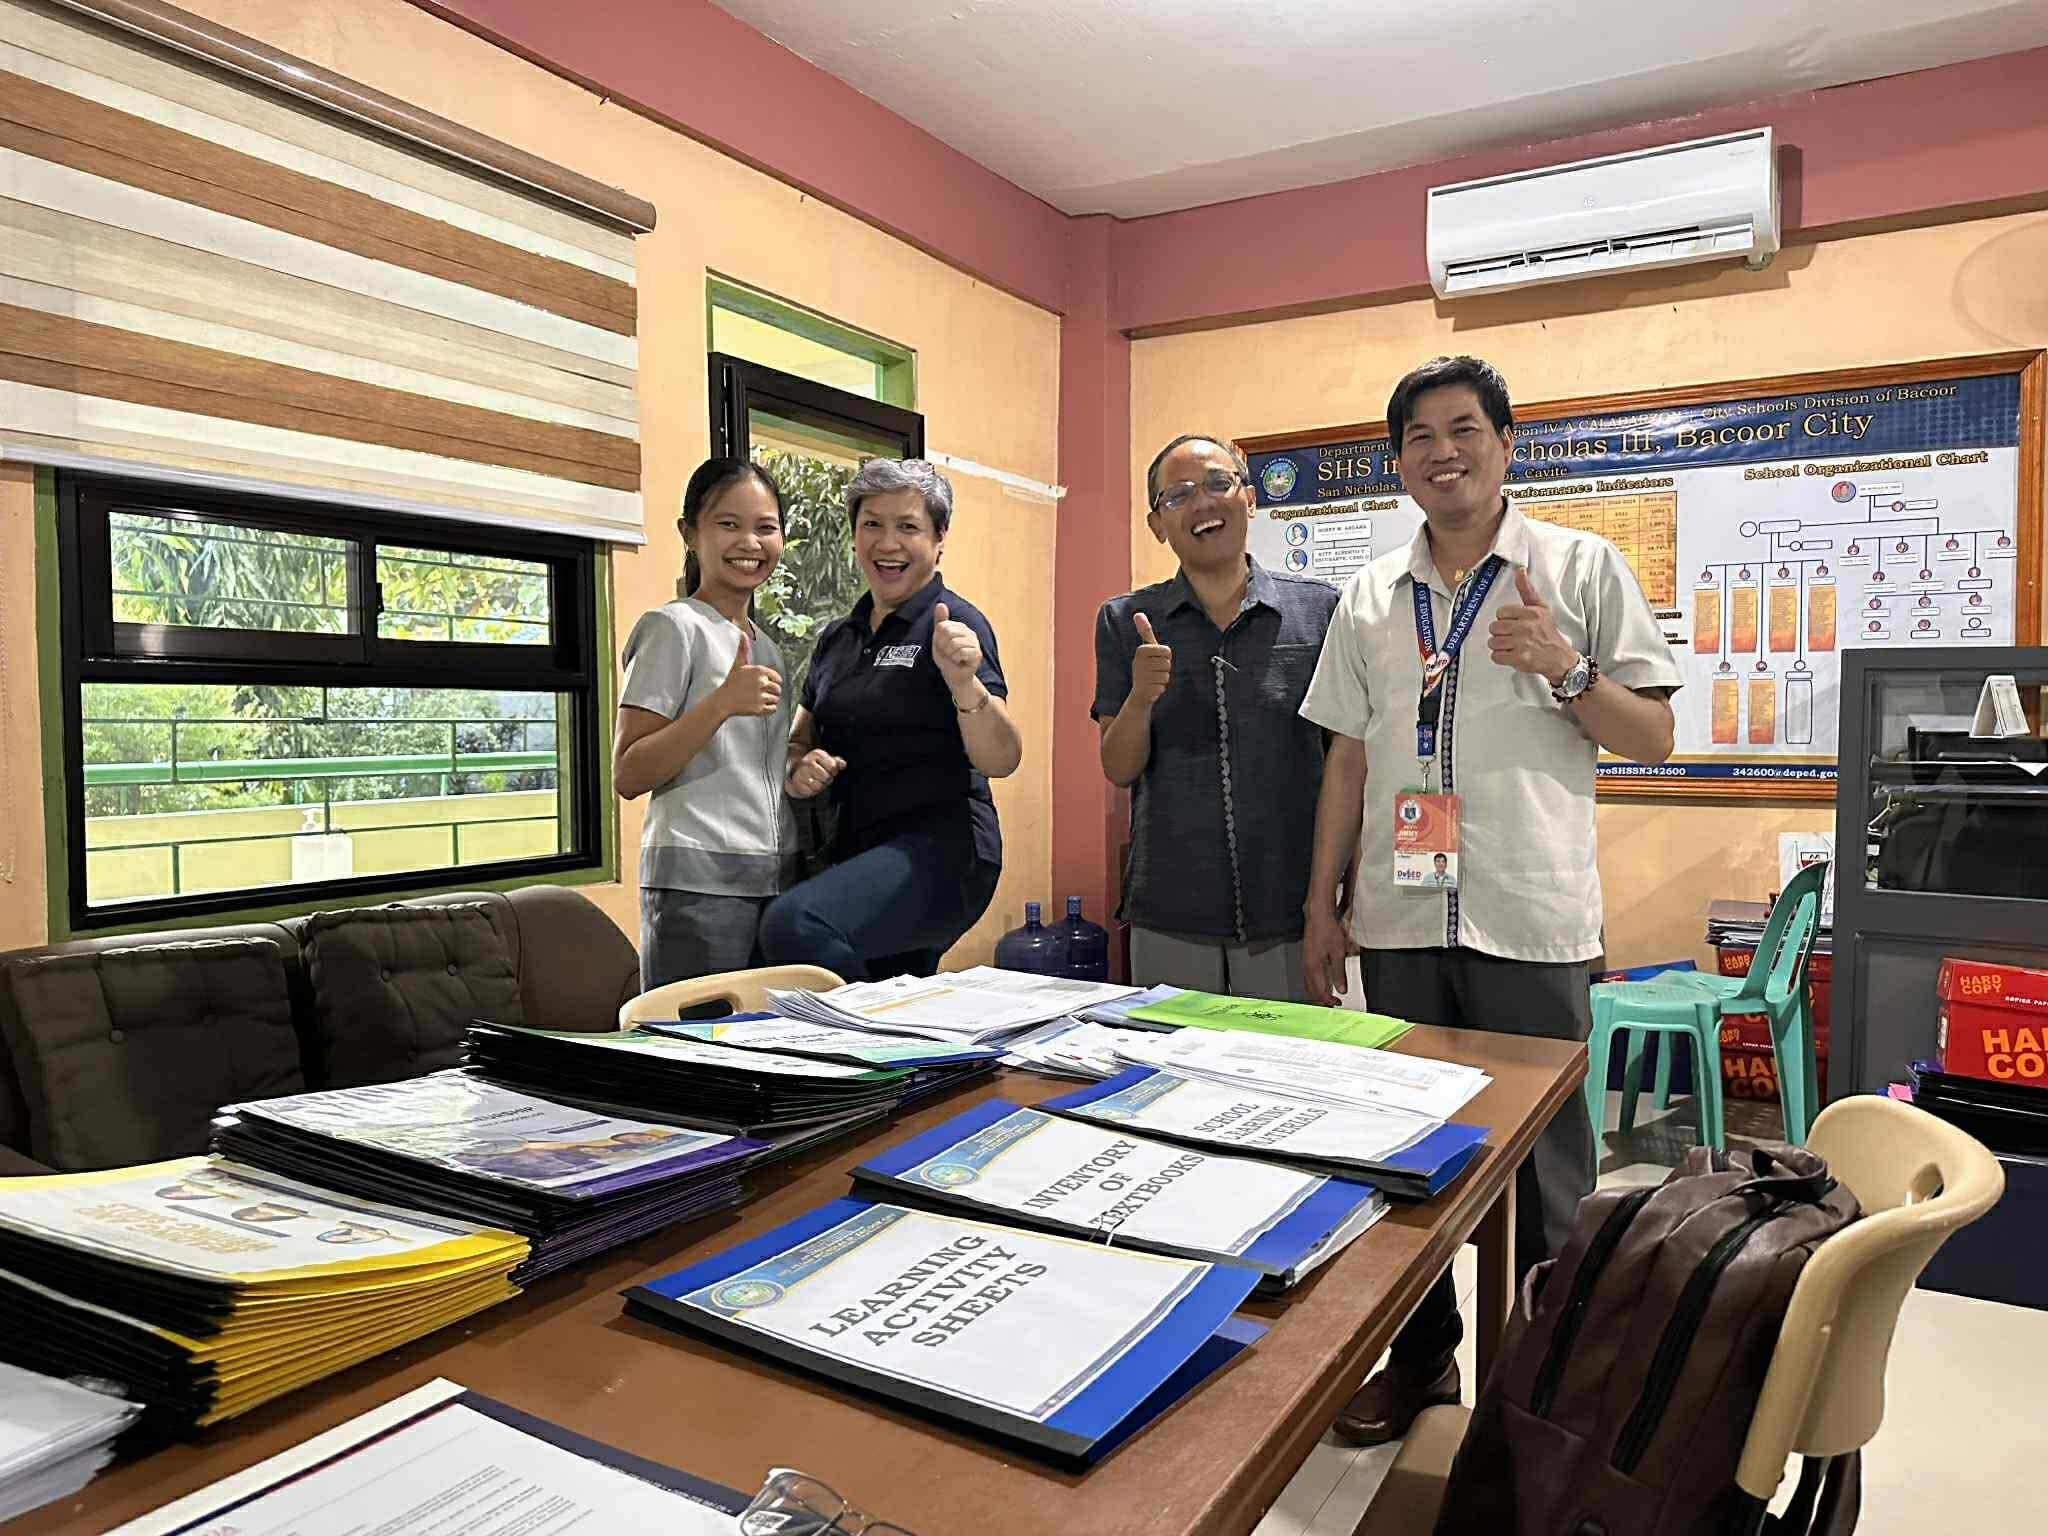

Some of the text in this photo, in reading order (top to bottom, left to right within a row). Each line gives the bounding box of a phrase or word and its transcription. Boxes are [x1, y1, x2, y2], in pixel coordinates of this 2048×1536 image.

[1513, 426, 1538, 440] gion
[1702, 407, 1731, 419] City
[1736, 400, 1798, 417] Schools
[1803, 393, 1870, 410] Division
[1876, 388, 1892, 402] of
[1897, 384, 1958, 400] Bacoor
[1319, 441, 1390, 458] Department
[1512, 411, 1875, 463] cholas III, Bacoor City
[1318, 457, 1372, 481] SHS
[1525, 466, 1568, 480] Cavite
[1744, 450, 1989, 480] School Organizational Chart
[1318, 486, 1340, 498] San
[1344, 482, 1397, 496] Nicholas
[1503, 476, 1674, 499] Performance Indicators
[1270, 498, 1399, 521] Organizational Chart
[1418, 603, 1434, 653] EDUCATION
[1447, 577, 1490, 649] DEPARTMENT OF
[1960, 975, 2001, 986] HARD
[1962, 984, 2002, 995] COPY
[1987, 1053, 2048, 1079] CO
[1193, 1103, 1260, 1133] SCHOOL
[1218, 1106, 1294, 1140] LEARNING
[1022, 1139, 1138, 1209] INVENTORY
[1098, 1172, 1134, 1191] OF
[1088, 1153, 1206, 1227] TEXTBOOKS
[808, 1236, 988, 1338] LEARNING
[862, 1245, 1017, 1347] ACTIVITY
[911, 1262, 1048, 1347] SHEETS
